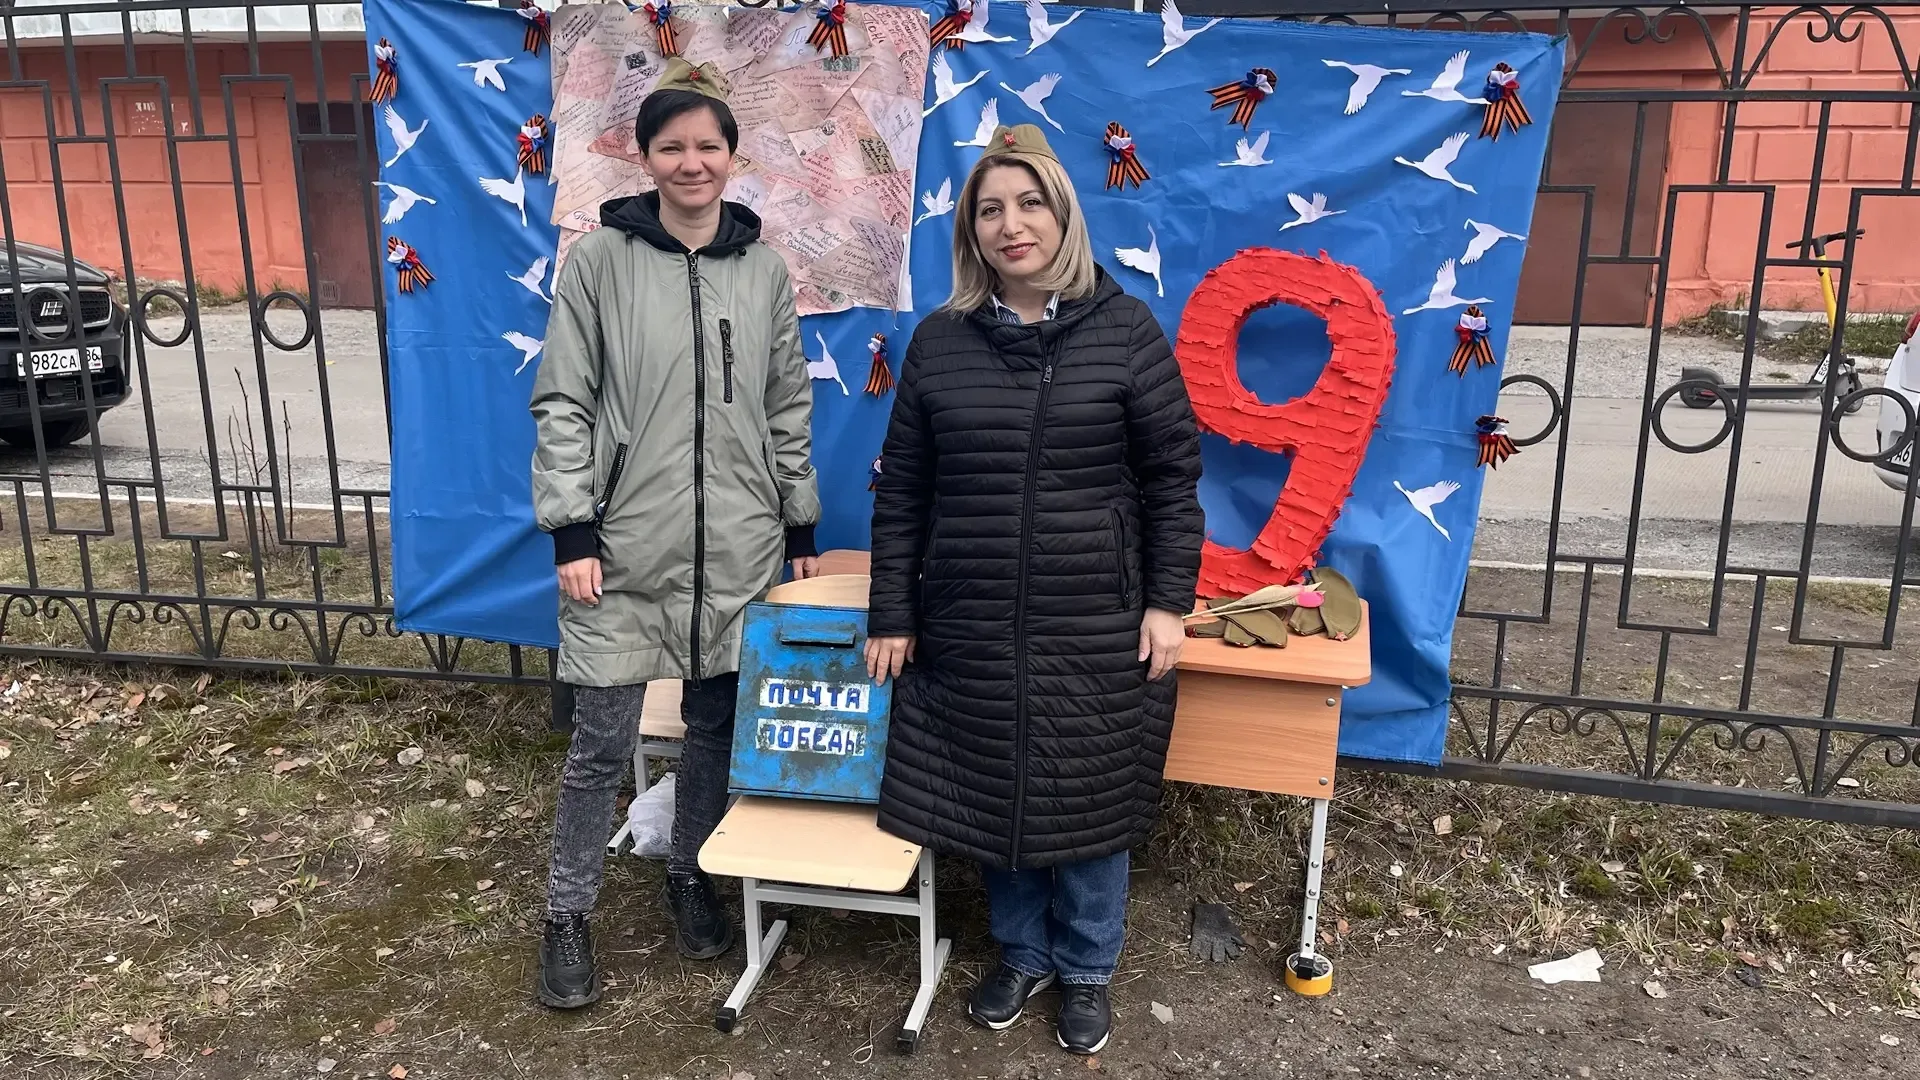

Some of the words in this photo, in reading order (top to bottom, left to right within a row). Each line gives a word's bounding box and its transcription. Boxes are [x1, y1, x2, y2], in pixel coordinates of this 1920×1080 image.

[19, 352, 78, 373] 982СА
[1176, 246, 1398, 599] 9
[768, 683, 861, 710] ПОЧТА
